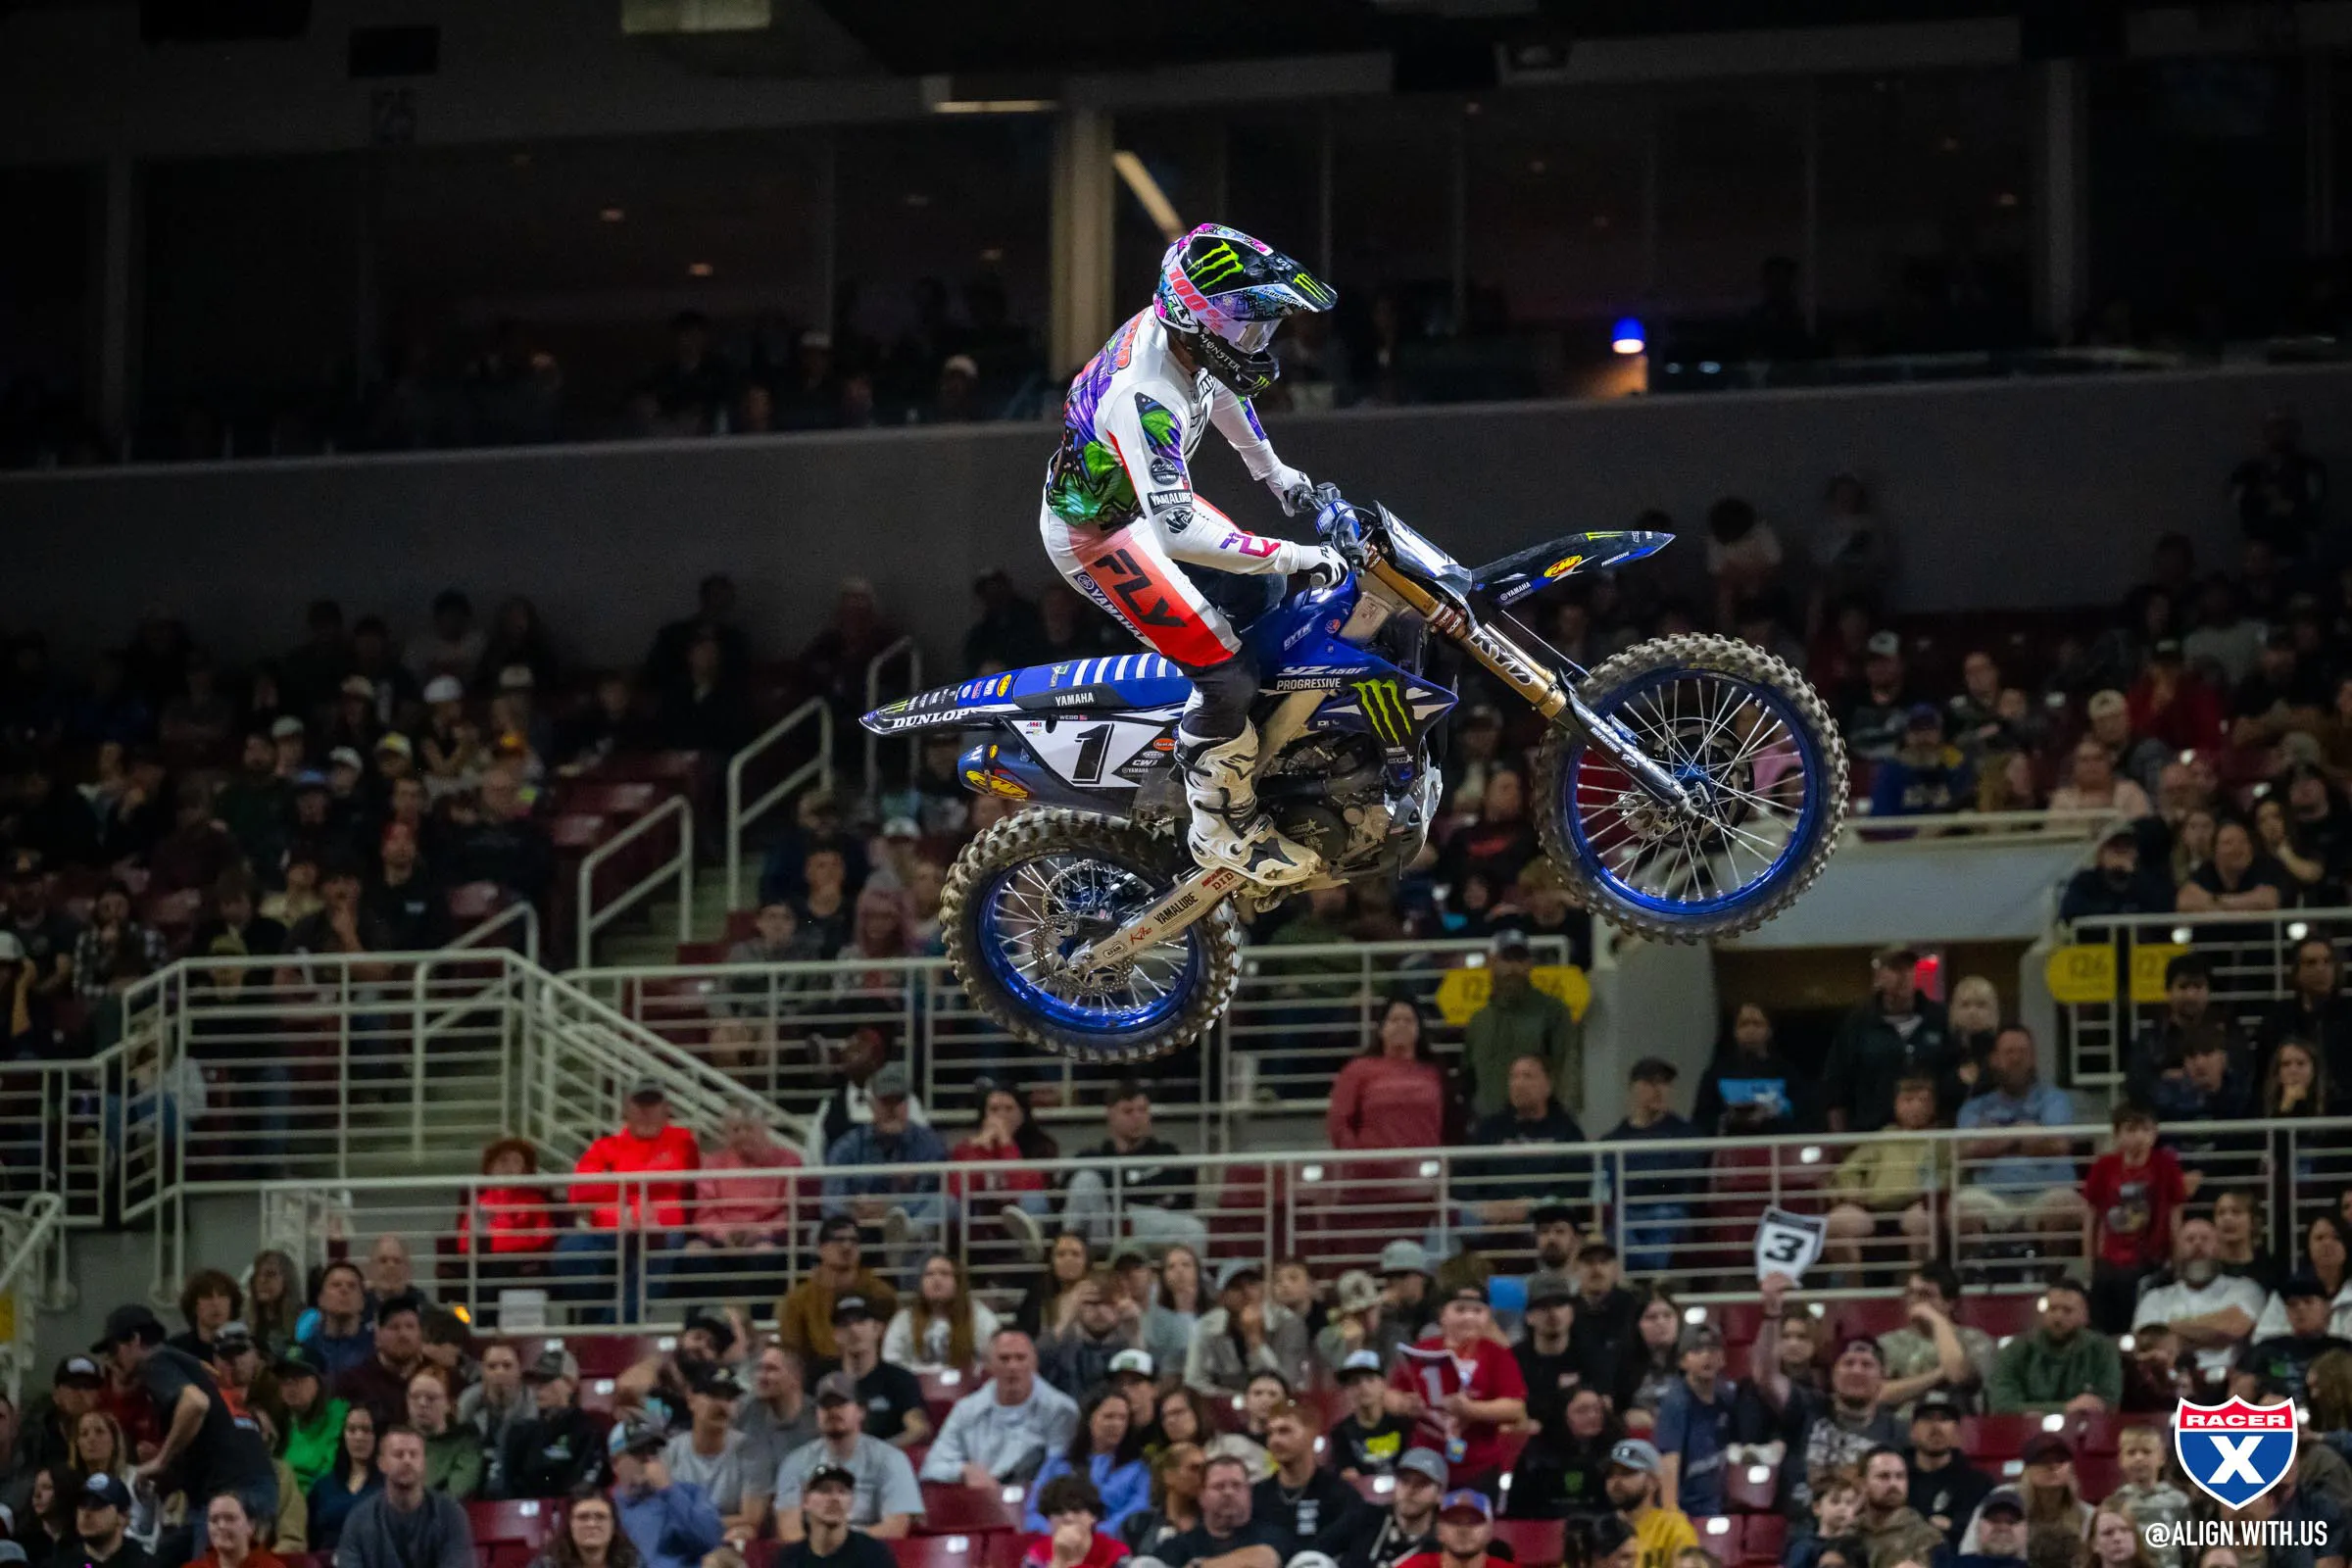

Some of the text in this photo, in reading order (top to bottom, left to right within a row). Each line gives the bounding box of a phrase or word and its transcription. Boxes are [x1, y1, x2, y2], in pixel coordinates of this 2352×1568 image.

[1219, 532, 1281, 559] FLY
[1093, 548, 1189, 627] FLY
[1506, 581, 1532, 598] YAMAHA
[1090, 588, 1146, 638] YAMAHA
[1276, 677, 1341, 691] PROGRESSIVE
[1055, 692, 1095, 707] YAMAHA
[892, 709, 968, 728] DUNLOP
[1070, 722, 1115, 785] 1
[1153, 891, 1200, 925] YAMALUBE
[1765, 1233, 1806, 1262] 3
